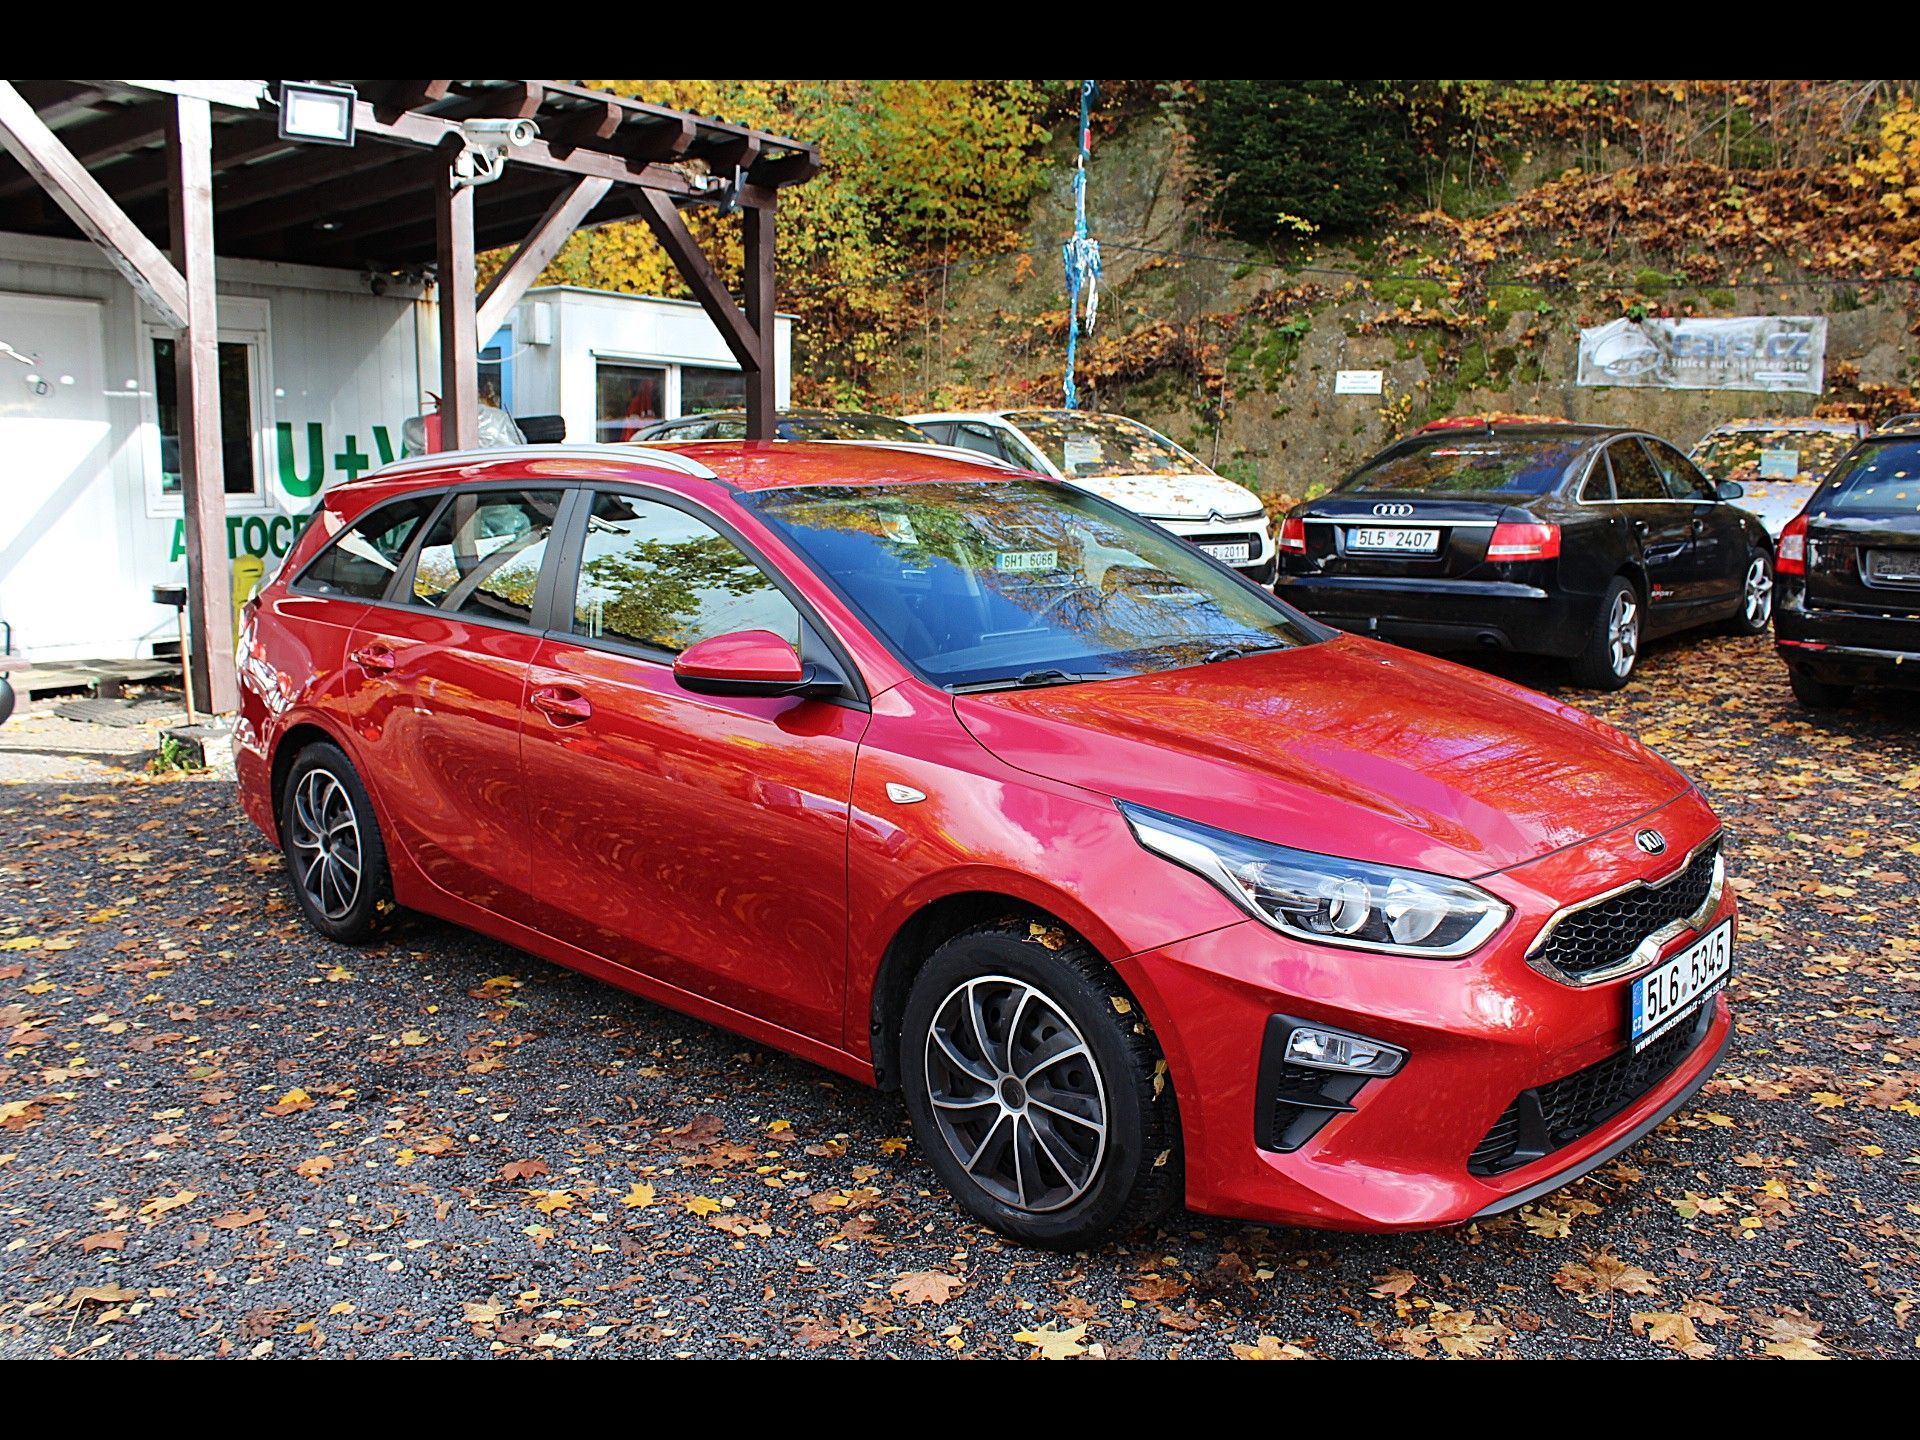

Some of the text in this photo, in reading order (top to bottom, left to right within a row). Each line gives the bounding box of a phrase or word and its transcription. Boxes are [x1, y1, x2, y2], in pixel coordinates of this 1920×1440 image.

[1359, 531, 1432, 548] 5L5 2407
[1224, 546, 1245, 558] 2011
[1647, 965, 1679, 1021] 5L6
[1691, 931, 1724, 991] 5345
[1632, 1016, 1642, 1032] CZ
